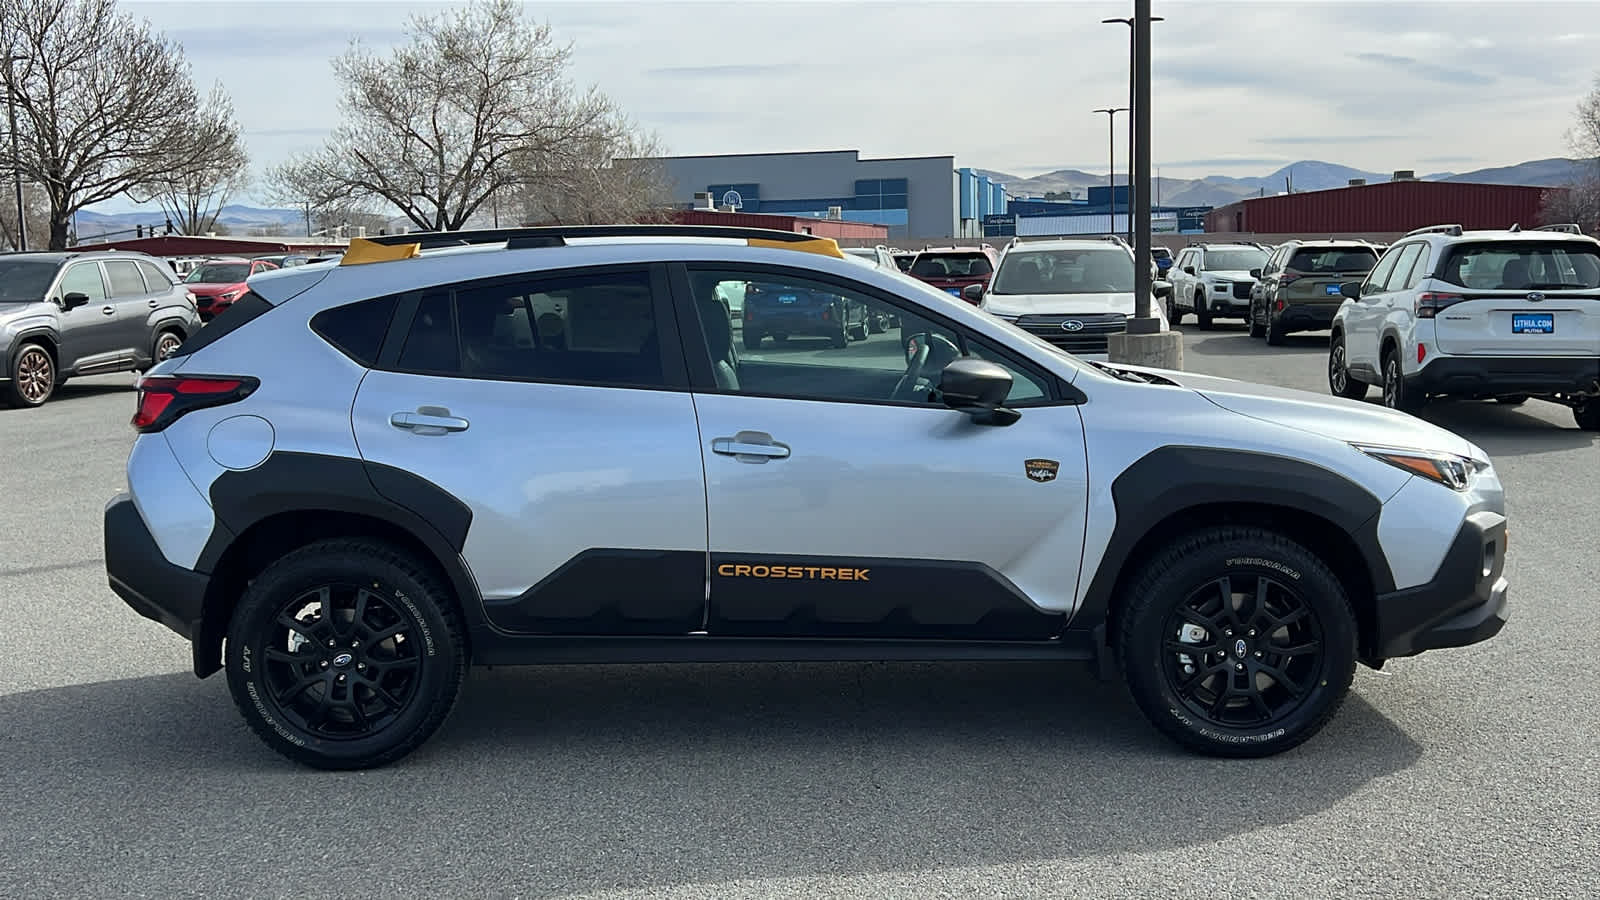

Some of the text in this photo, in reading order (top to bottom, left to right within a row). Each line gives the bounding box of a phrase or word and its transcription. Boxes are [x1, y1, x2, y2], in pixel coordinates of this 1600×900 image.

[1513, 319, 1553, 329] LITHIA.COM
[718, 564, 870, 581] CROSSTREK
[1225, 557, 1301, 581] YOKOHAMA
[394, 589, 436, 657] YOKOHAMA
[246, 681, 305, 747] GEOLANDAR
[1199, 727, 1286, 744] GEOLANDAR
